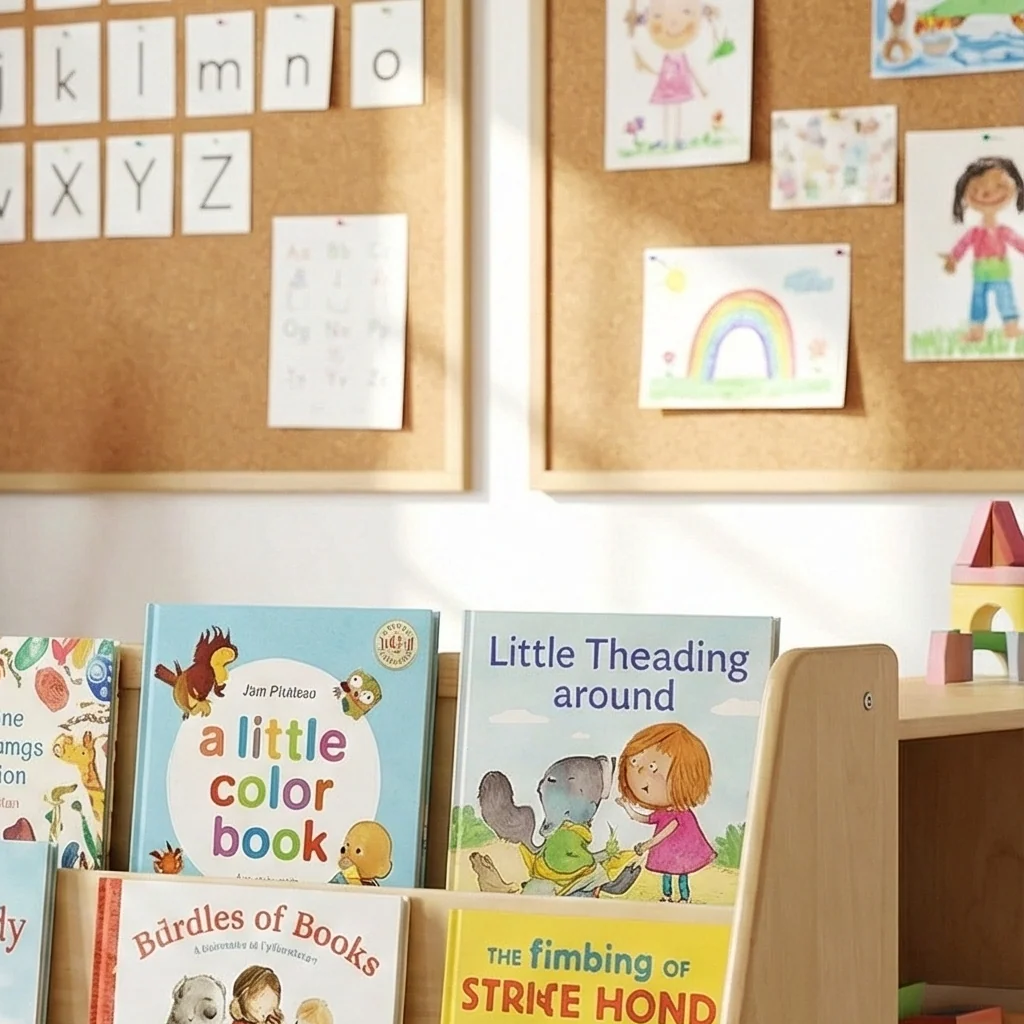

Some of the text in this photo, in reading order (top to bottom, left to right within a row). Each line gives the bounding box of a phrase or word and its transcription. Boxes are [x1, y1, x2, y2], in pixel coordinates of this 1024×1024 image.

[56, 48, 77, 101] k
[199, 57, 241, 92] m
[286, 54, 310, 88] n
[51, 162, 83, 217] X
[123, 158, 156, 213] Y
[199, 155, 232, 211] Z
[490, 635, 750, 683] Little Theading
[553, 679, 675, 711] around
[199, 715, 347, 763] a little
[210, 765, 334, 812] color
[212, 815, 328, 863] book
[254, 904, 288, 932] of
[292, 911, 380, 977] Books
[487, 938, 691, 983] THE fimbing OF
